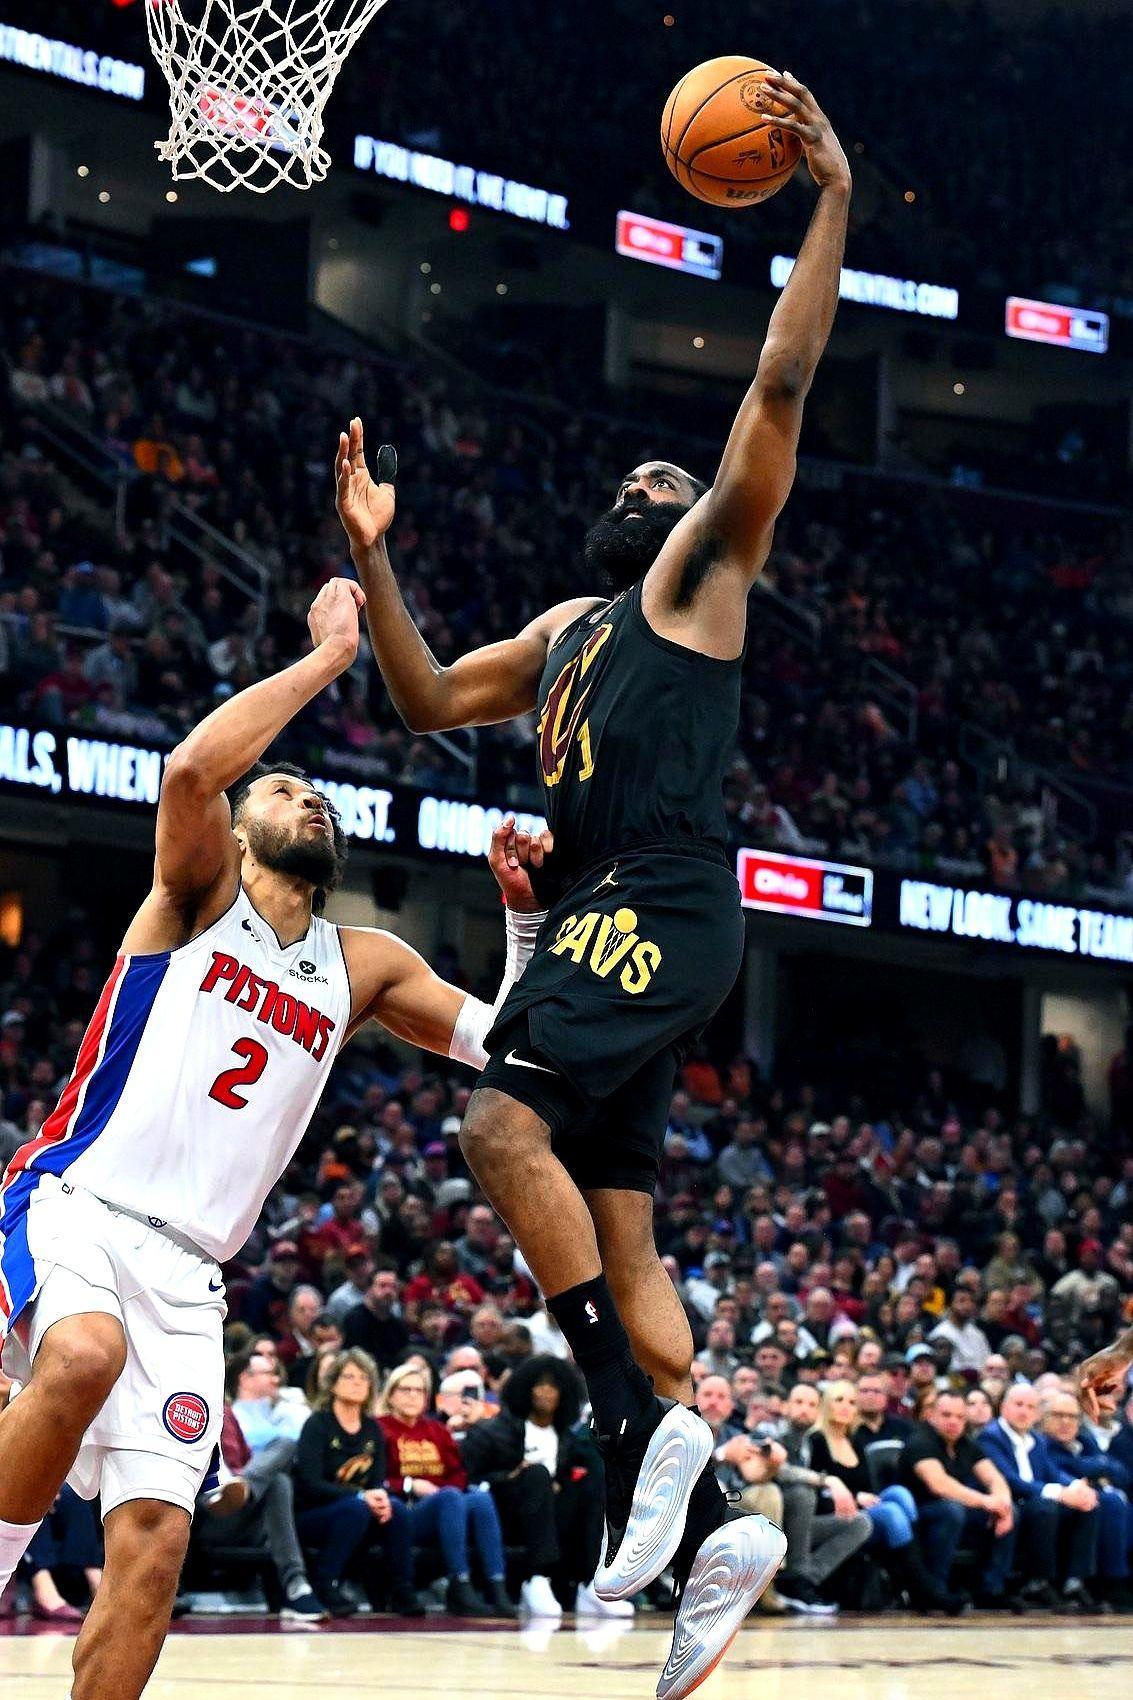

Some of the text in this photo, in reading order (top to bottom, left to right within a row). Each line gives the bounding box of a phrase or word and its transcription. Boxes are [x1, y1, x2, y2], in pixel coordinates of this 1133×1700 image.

[67, 736, 162, 804] WHEN
[899, 879, 954, 932] NEW
[1016, 899, 1077, 954] SAME
[199, 950, 336, 1063] PISTONS
[207, 1036, 269, 1110] 2
[172, 1410, 201, 1431] PISTONS
[174, 1402, 203, 1421] DETROIT
